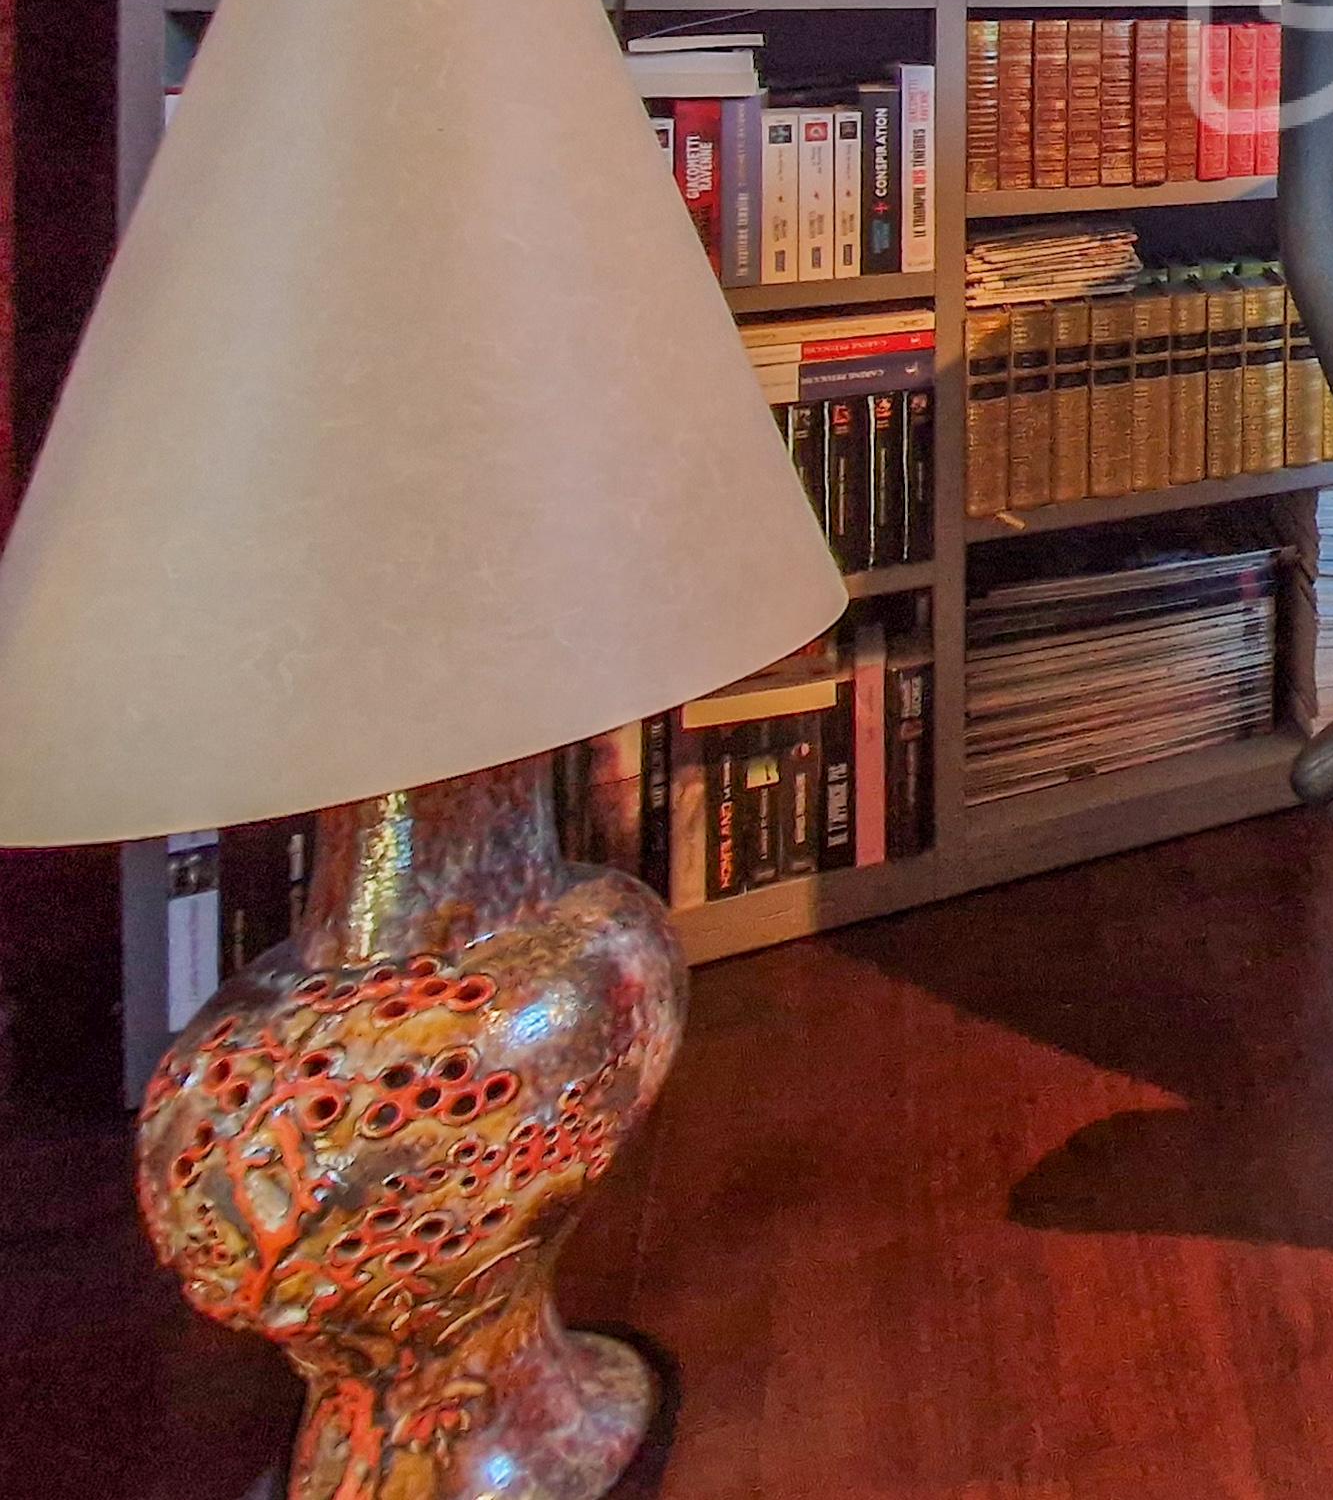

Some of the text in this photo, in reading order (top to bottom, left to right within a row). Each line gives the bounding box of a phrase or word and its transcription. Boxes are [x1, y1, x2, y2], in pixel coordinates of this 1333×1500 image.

[686, 136, 700, 199] GIACOMETTI
[700, 142, 712, 191] RAVENNE
[874, 107, 889, 197] CONSPIRATION
[910, 129, 926, 167] TÉNÈBRES
[912, 170, 926, 185] DES
[912, 187, 926, 228] TRIOMPHE
[720, 801, 734, 888] HOMELAND
